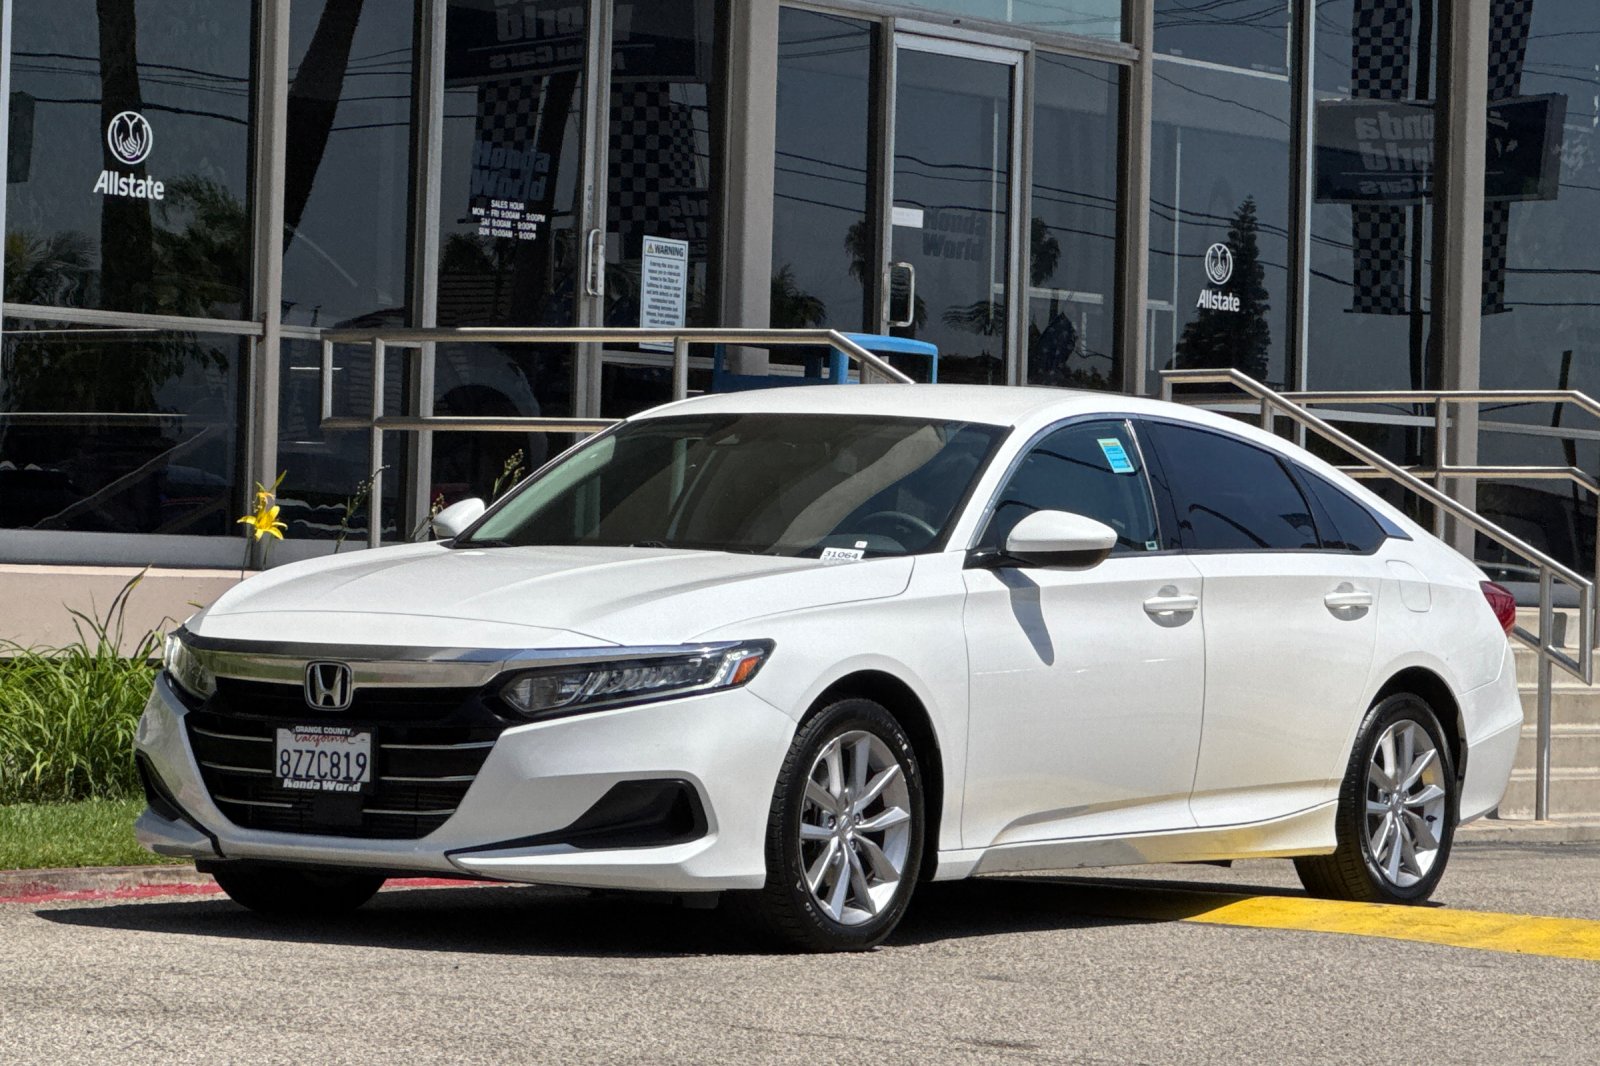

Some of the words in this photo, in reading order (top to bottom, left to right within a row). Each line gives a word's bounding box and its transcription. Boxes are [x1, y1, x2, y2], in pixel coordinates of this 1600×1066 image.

[93, 169, 165, 200] Allstate
[491, 200, 508, 209] SALES
[472, 207, 485, 216] MON
[491, 209, 500, 218] FRI
[478, 227, 491, 236] SUN
[654, 243, 684, 257] WARNING
[1196, 289, 1240, 312] Allstate
[295, 725, 322, 734] ORANGE
[323, 727, 352, 735] COUNTY
[280, 749, 367, 783] 8ZZC819
[282, 778, 321, 790] Honda
